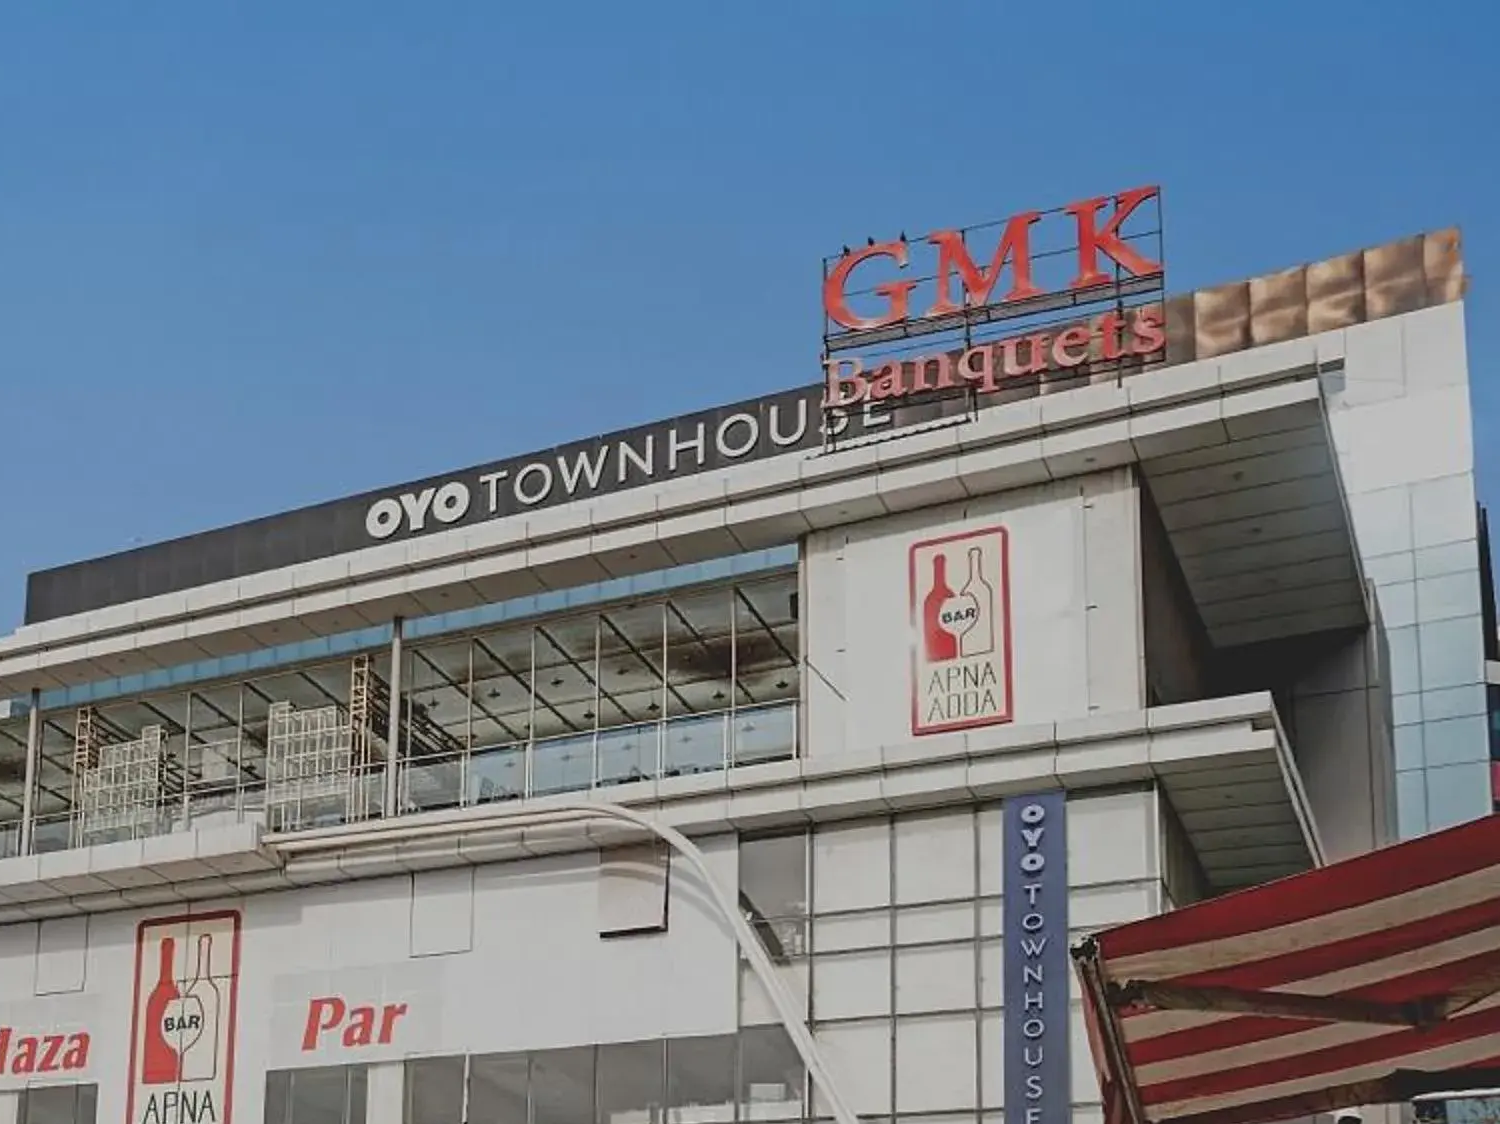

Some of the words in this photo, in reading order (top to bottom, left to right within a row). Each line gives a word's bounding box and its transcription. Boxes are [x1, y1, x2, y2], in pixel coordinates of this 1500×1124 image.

[822, 185, 1164, 331] GMK
[820, 304, 1167, 409] Banquets
[365, 481, 469, 539] OYO
[480, 392, 893, 513] TOWNHOUSE
[941, 606, 976, 625] BAR
[926, 688, 998, 724] ADDA
[927, 661, 998, 696] APNA
[1021, 803, 1046, 873] OYO
[163, 1014, 201, 1033] BAR
[301, 996, 408, 1051] Par
